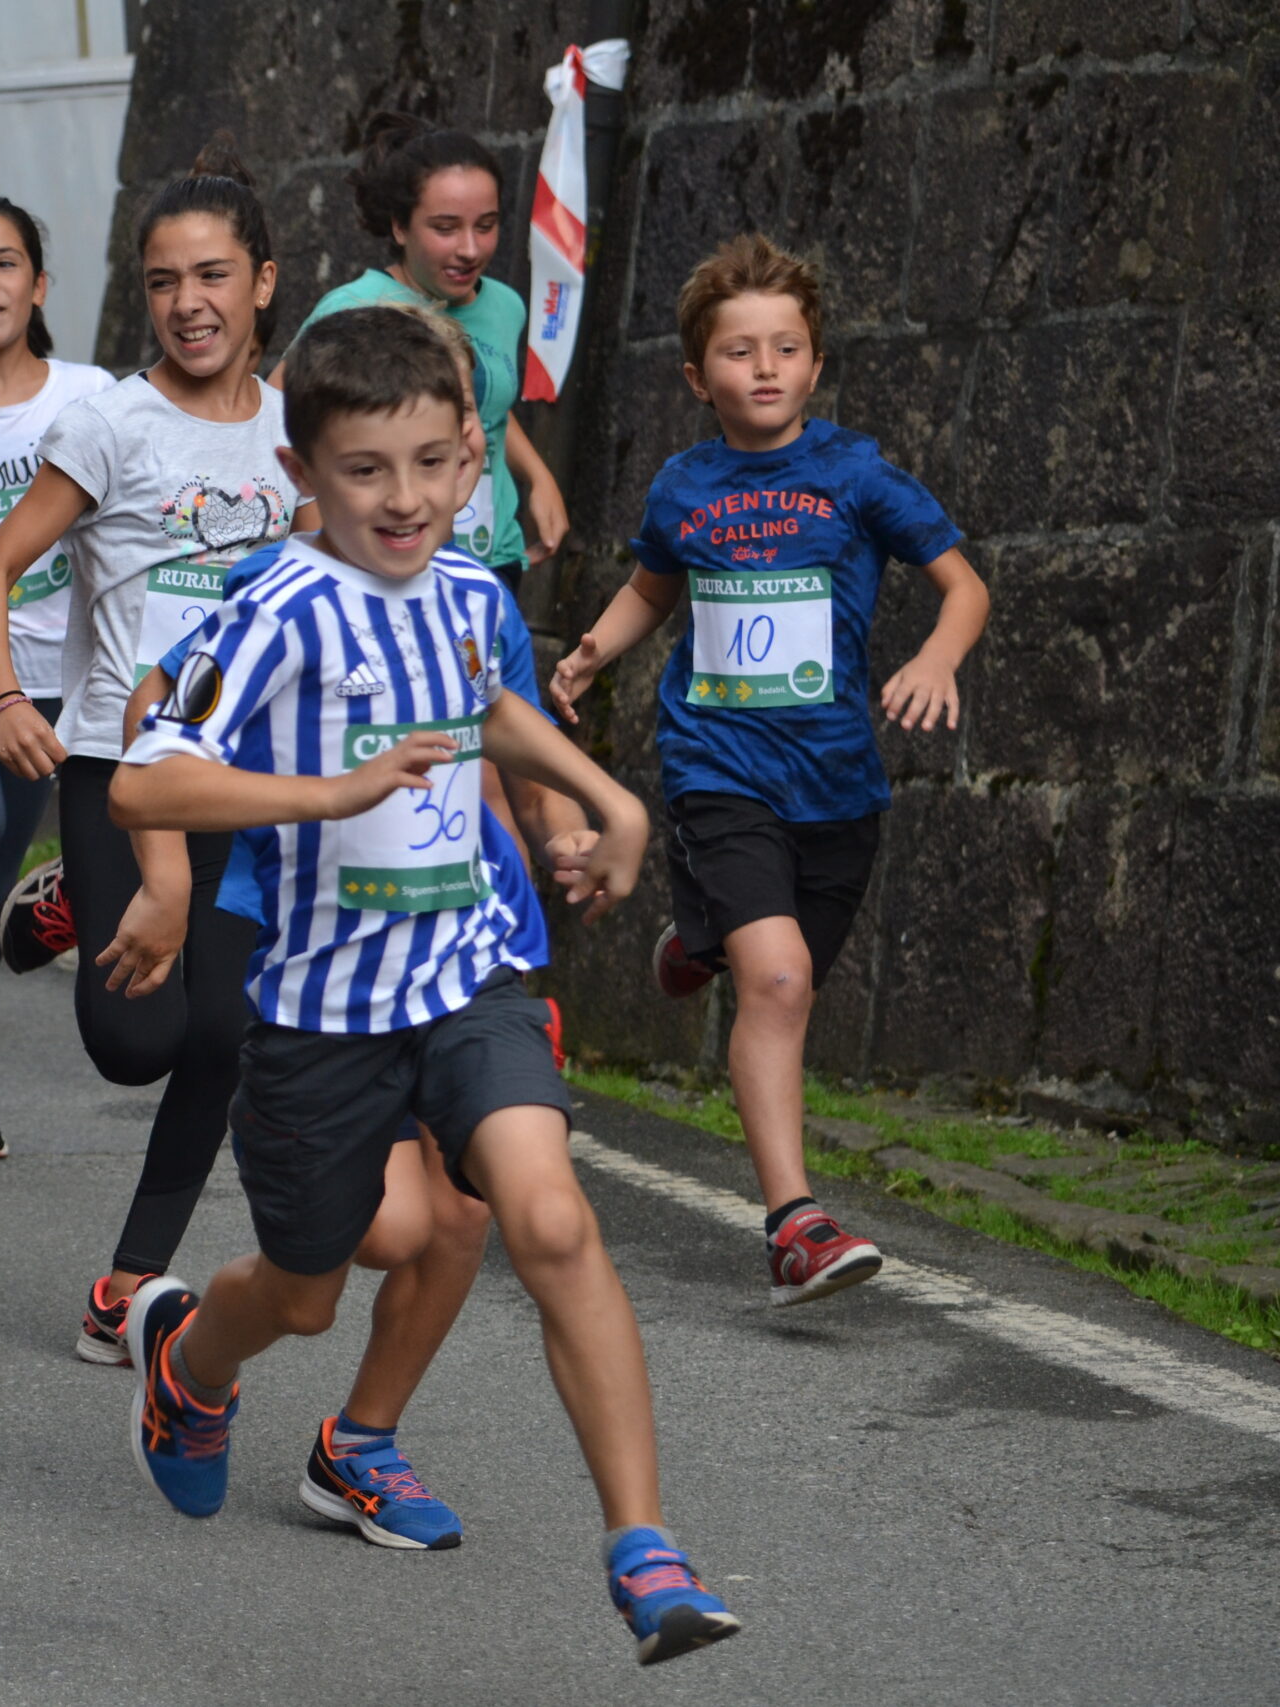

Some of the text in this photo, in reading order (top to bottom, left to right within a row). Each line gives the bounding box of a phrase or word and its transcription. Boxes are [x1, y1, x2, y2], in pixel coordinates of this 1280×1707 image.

[679, 490, 835, 540] ADVENTURE
[710, 517, 799, 545] CALLING
[156, 567, 223, 592] RURAL
[696, 575, 825, 596] RURAL KUTXA
[726, 614, 775, 667] 10
[336, 683, 385, 697] adidas
[408, 761, 466, 851] 36
